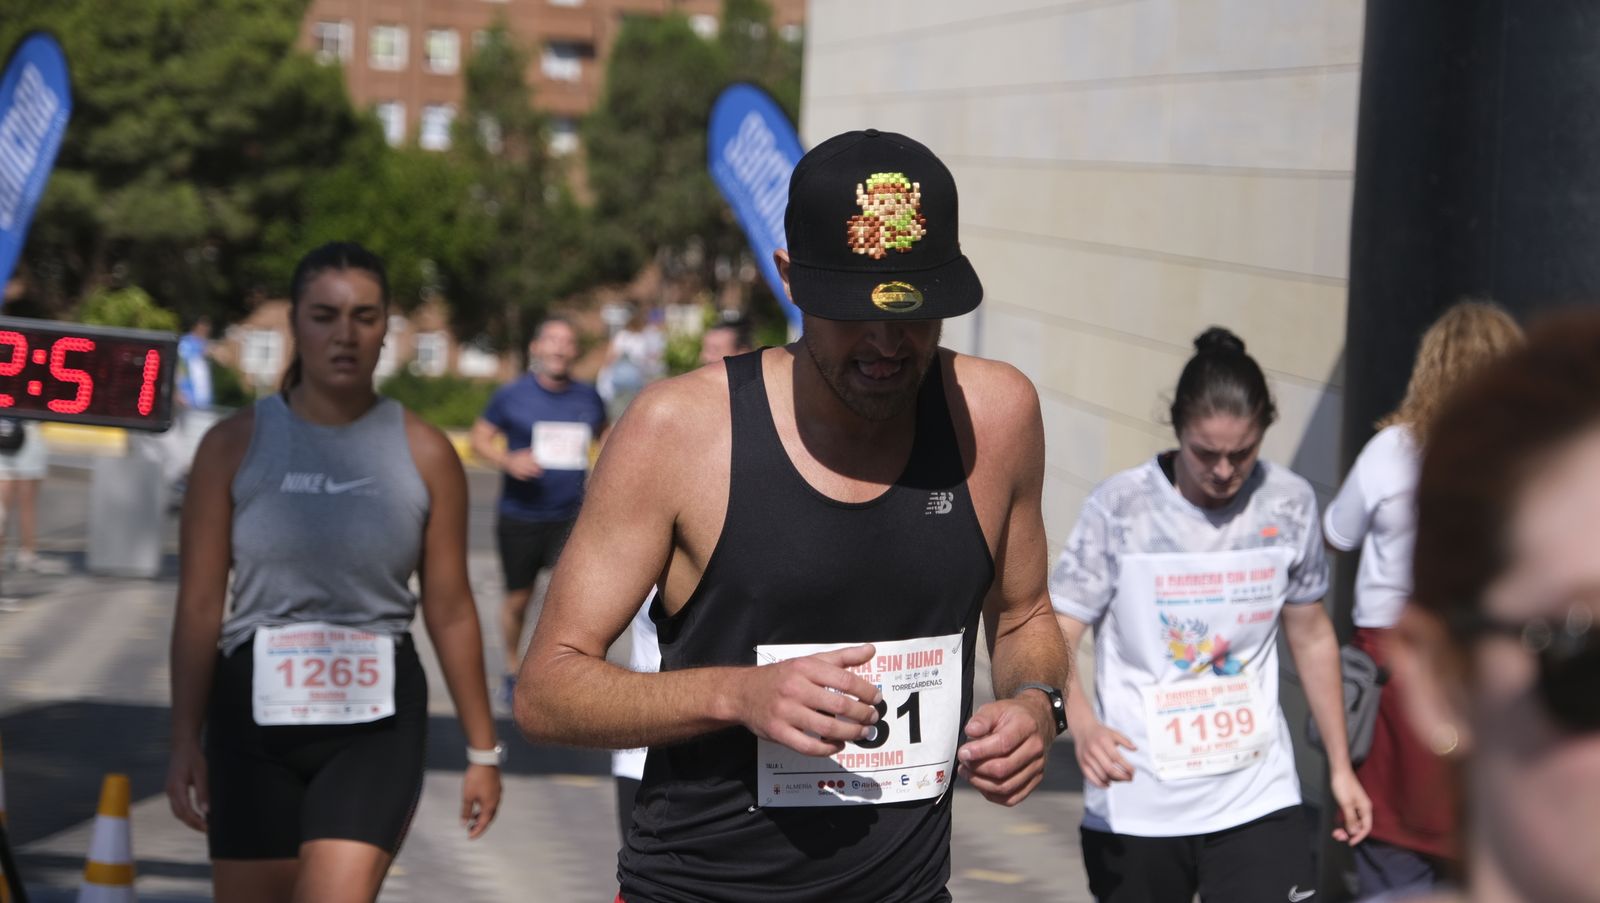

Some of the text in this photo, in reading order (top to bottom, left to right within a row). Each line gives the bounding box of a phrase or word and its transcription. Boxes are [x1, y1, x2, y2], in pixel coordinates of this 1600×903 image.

[280, 472, 325, 494] NIKE
[877, 654, 903, 673] SIN
[906, 648, 944, 670] HUMO
[275, 657, 380, 688] 1265
[891, 678, 943, 692] TORRECÁRDENAS
[1165, 707, 1255, 746] 1199
[837, 750, 904, 769] TOPISIMO
